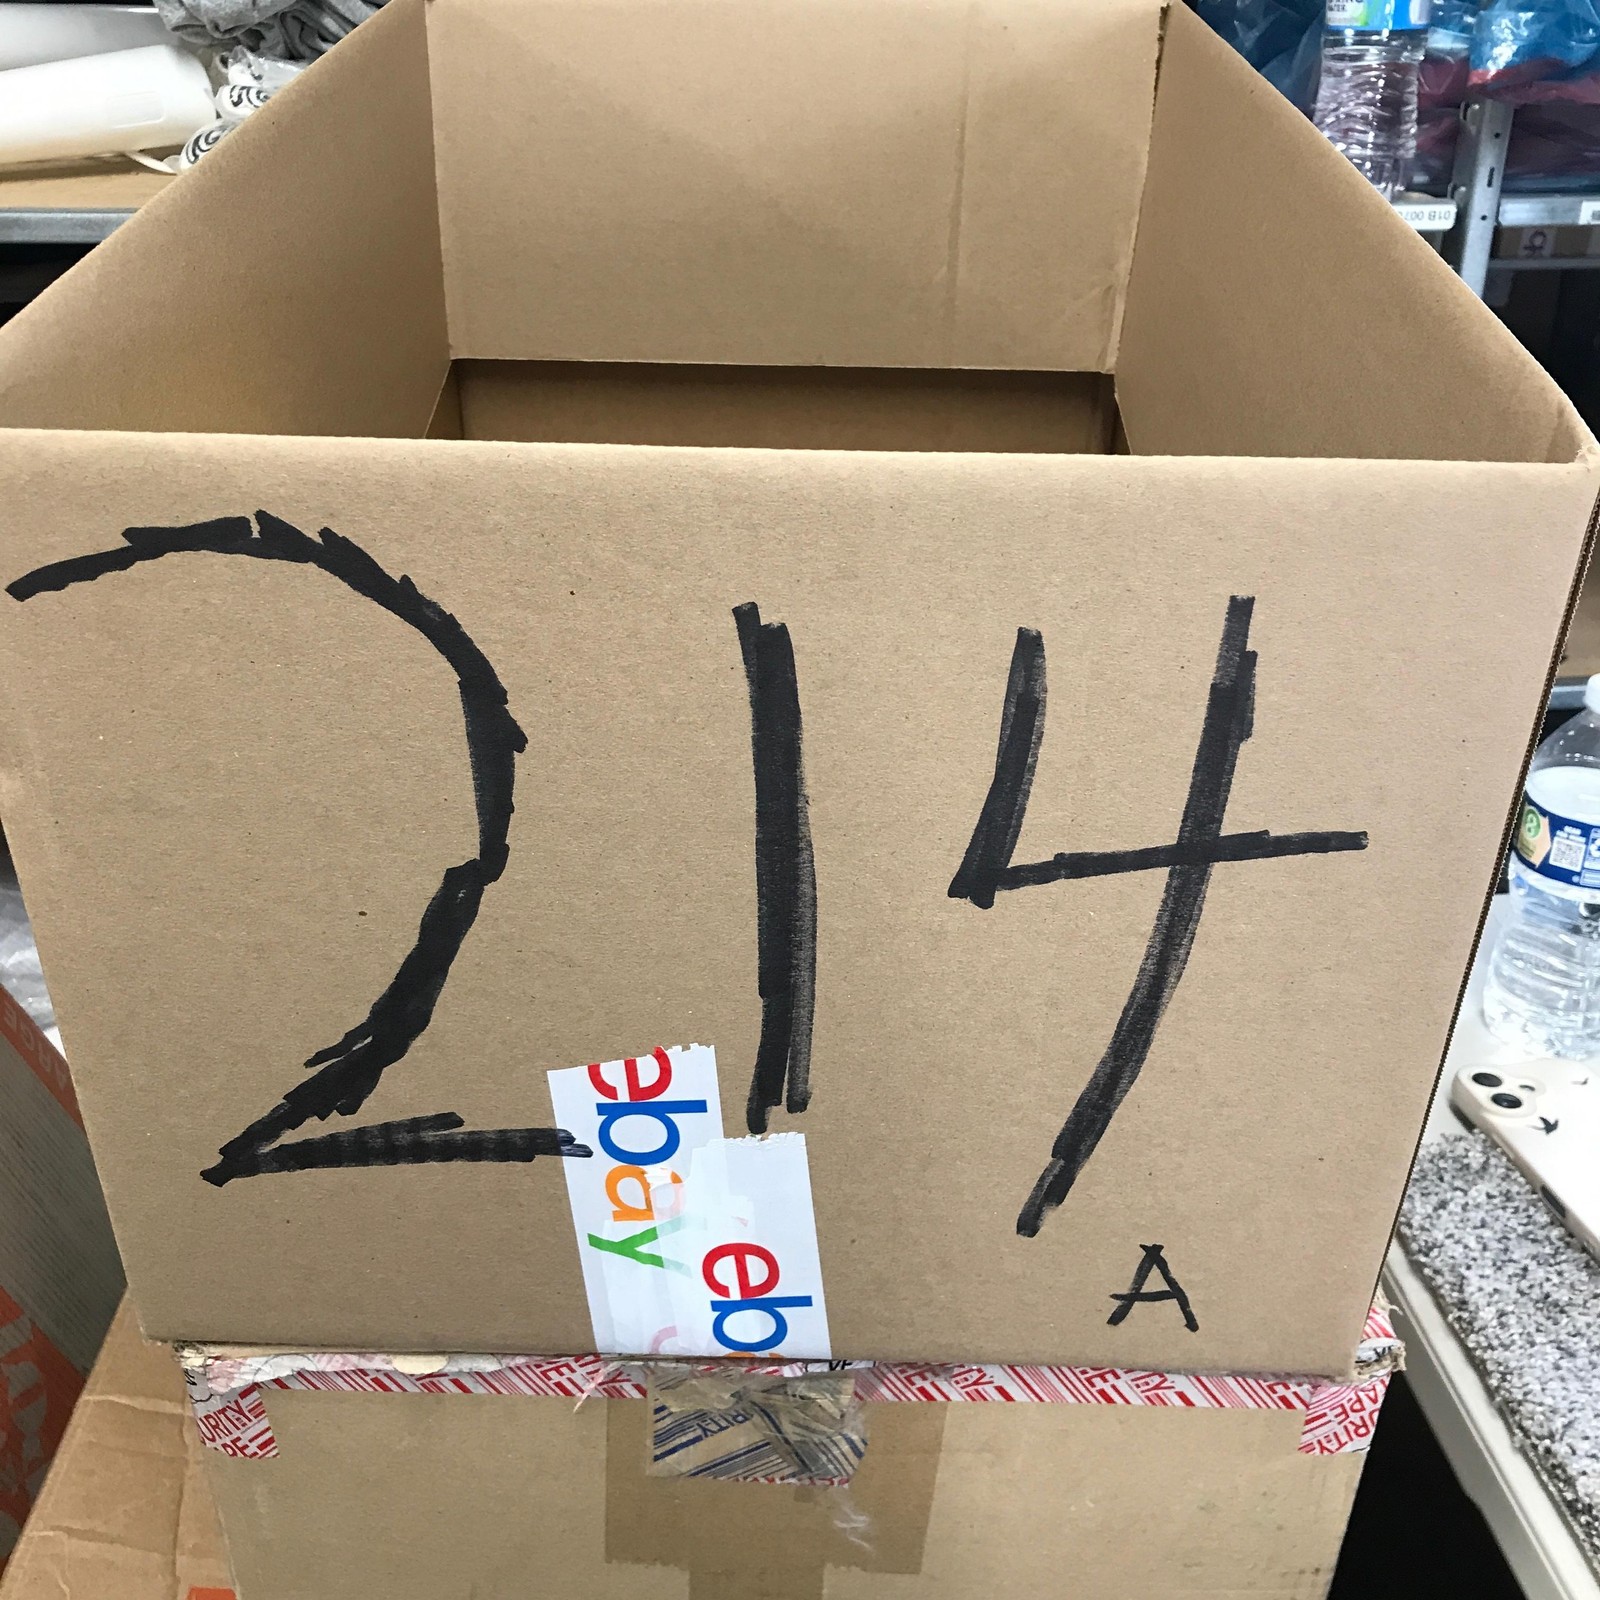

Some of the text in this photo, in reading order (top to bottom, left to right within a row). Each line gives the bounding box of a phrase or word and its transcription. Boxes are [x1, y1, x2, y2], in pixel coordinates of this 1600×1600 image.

[1428, 210, 1451, 222] 01B
[5, 510, 1368, 1238] 214
[701, 1242, 813, 1358] eb
[1107, 1243, 1199, 1333] A
[220, 1436, 259, 1459] PE
